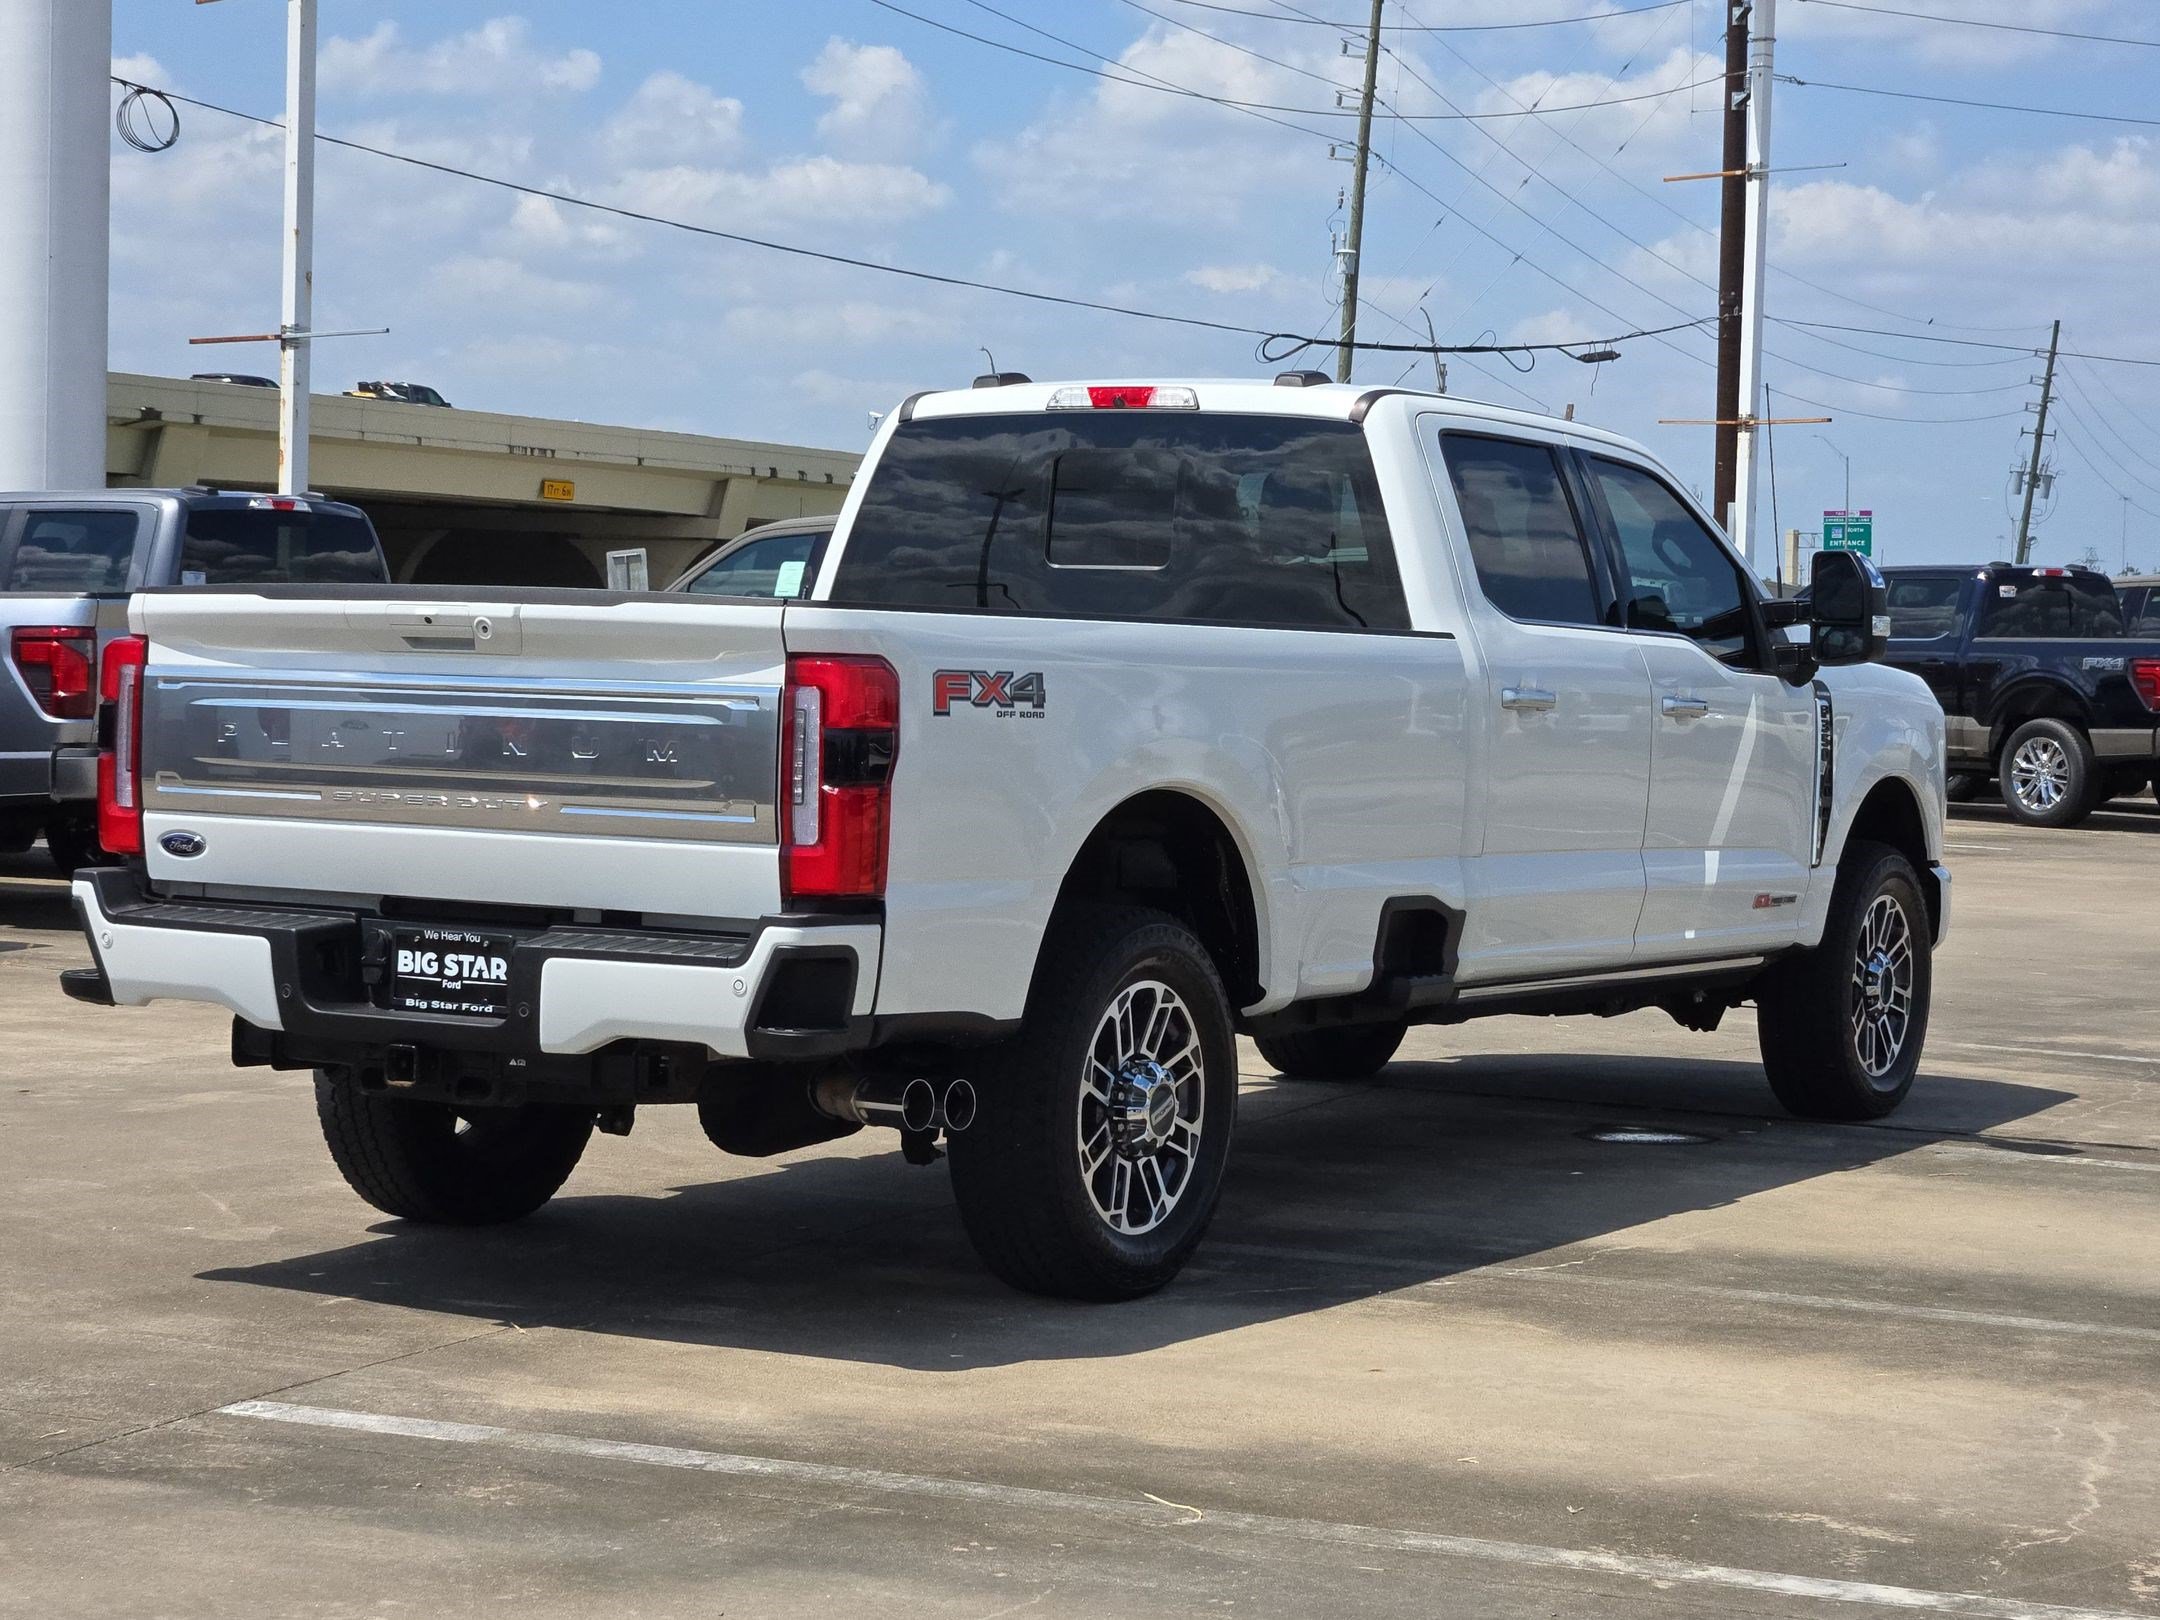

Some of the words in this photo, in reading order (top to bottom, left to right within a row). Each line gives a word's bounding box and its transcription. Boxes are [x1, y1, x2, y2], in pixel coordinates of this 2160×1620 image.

[2082, 658, 2125, 671] FX4
[933, 670, 1046, 716] FX4
[996, 710, 1016, 719] OFF
[1019, 711, 1045, 719] ROAD
[331, 790, 449, 807] SUPER
[423, 930, 440, 940] We
[441, 931, 463, 942] Hear
[464, 933, 482, 944] You
[397, 949, 439, 975] BIG
[443, 953, 508, 981] STAR
[442, 979, 462, 990] Ford
[405, 998, 428, 1009] Big
[431, 1000, 459, 1011] Star
[461, 1002, 494, 1013] Ford
